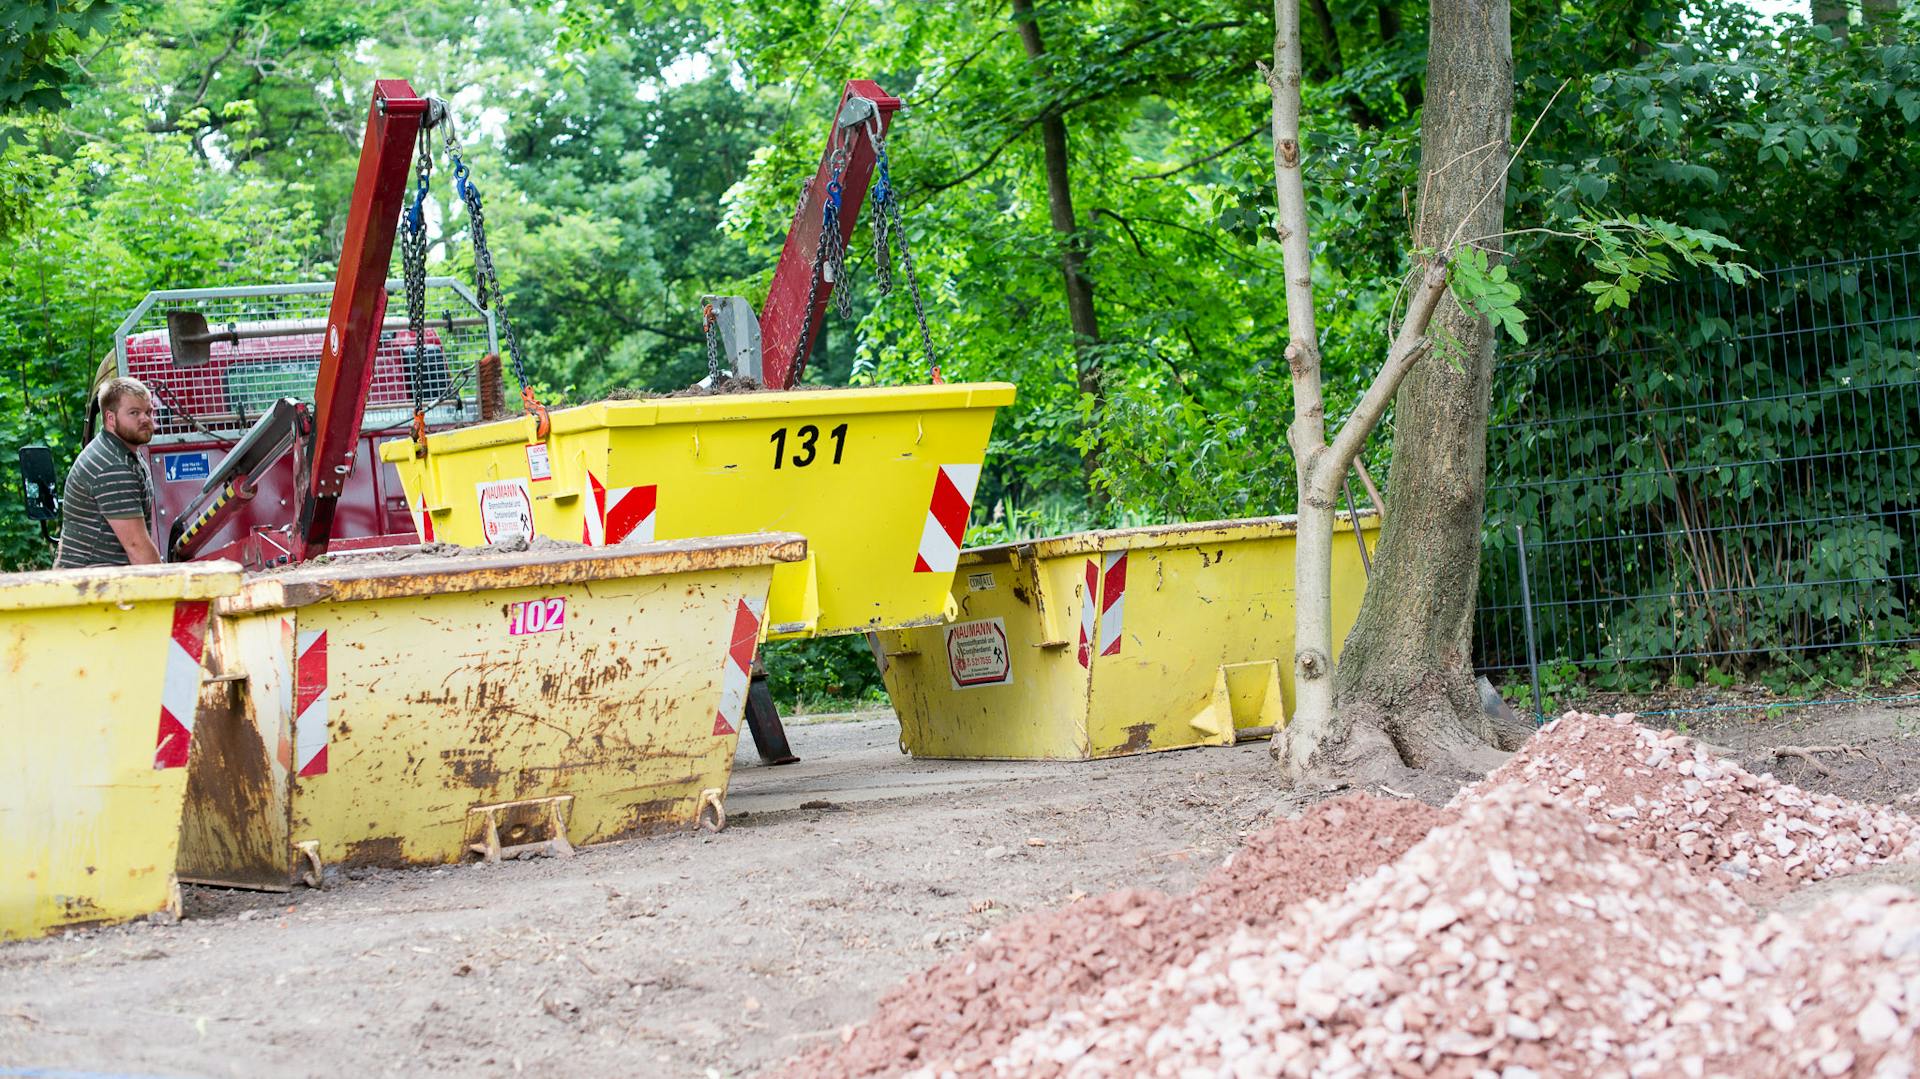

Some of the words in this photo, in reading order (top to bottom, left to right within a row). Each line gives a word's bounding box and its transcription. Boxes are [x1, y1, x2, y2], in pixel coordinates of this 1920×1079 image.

[770, 424, 848, 470] 131
[485, 484, 518, 499] NAUMANN
[513, 598, 564, 635] 102
[953, 621, 992, 639] NAUMANN
